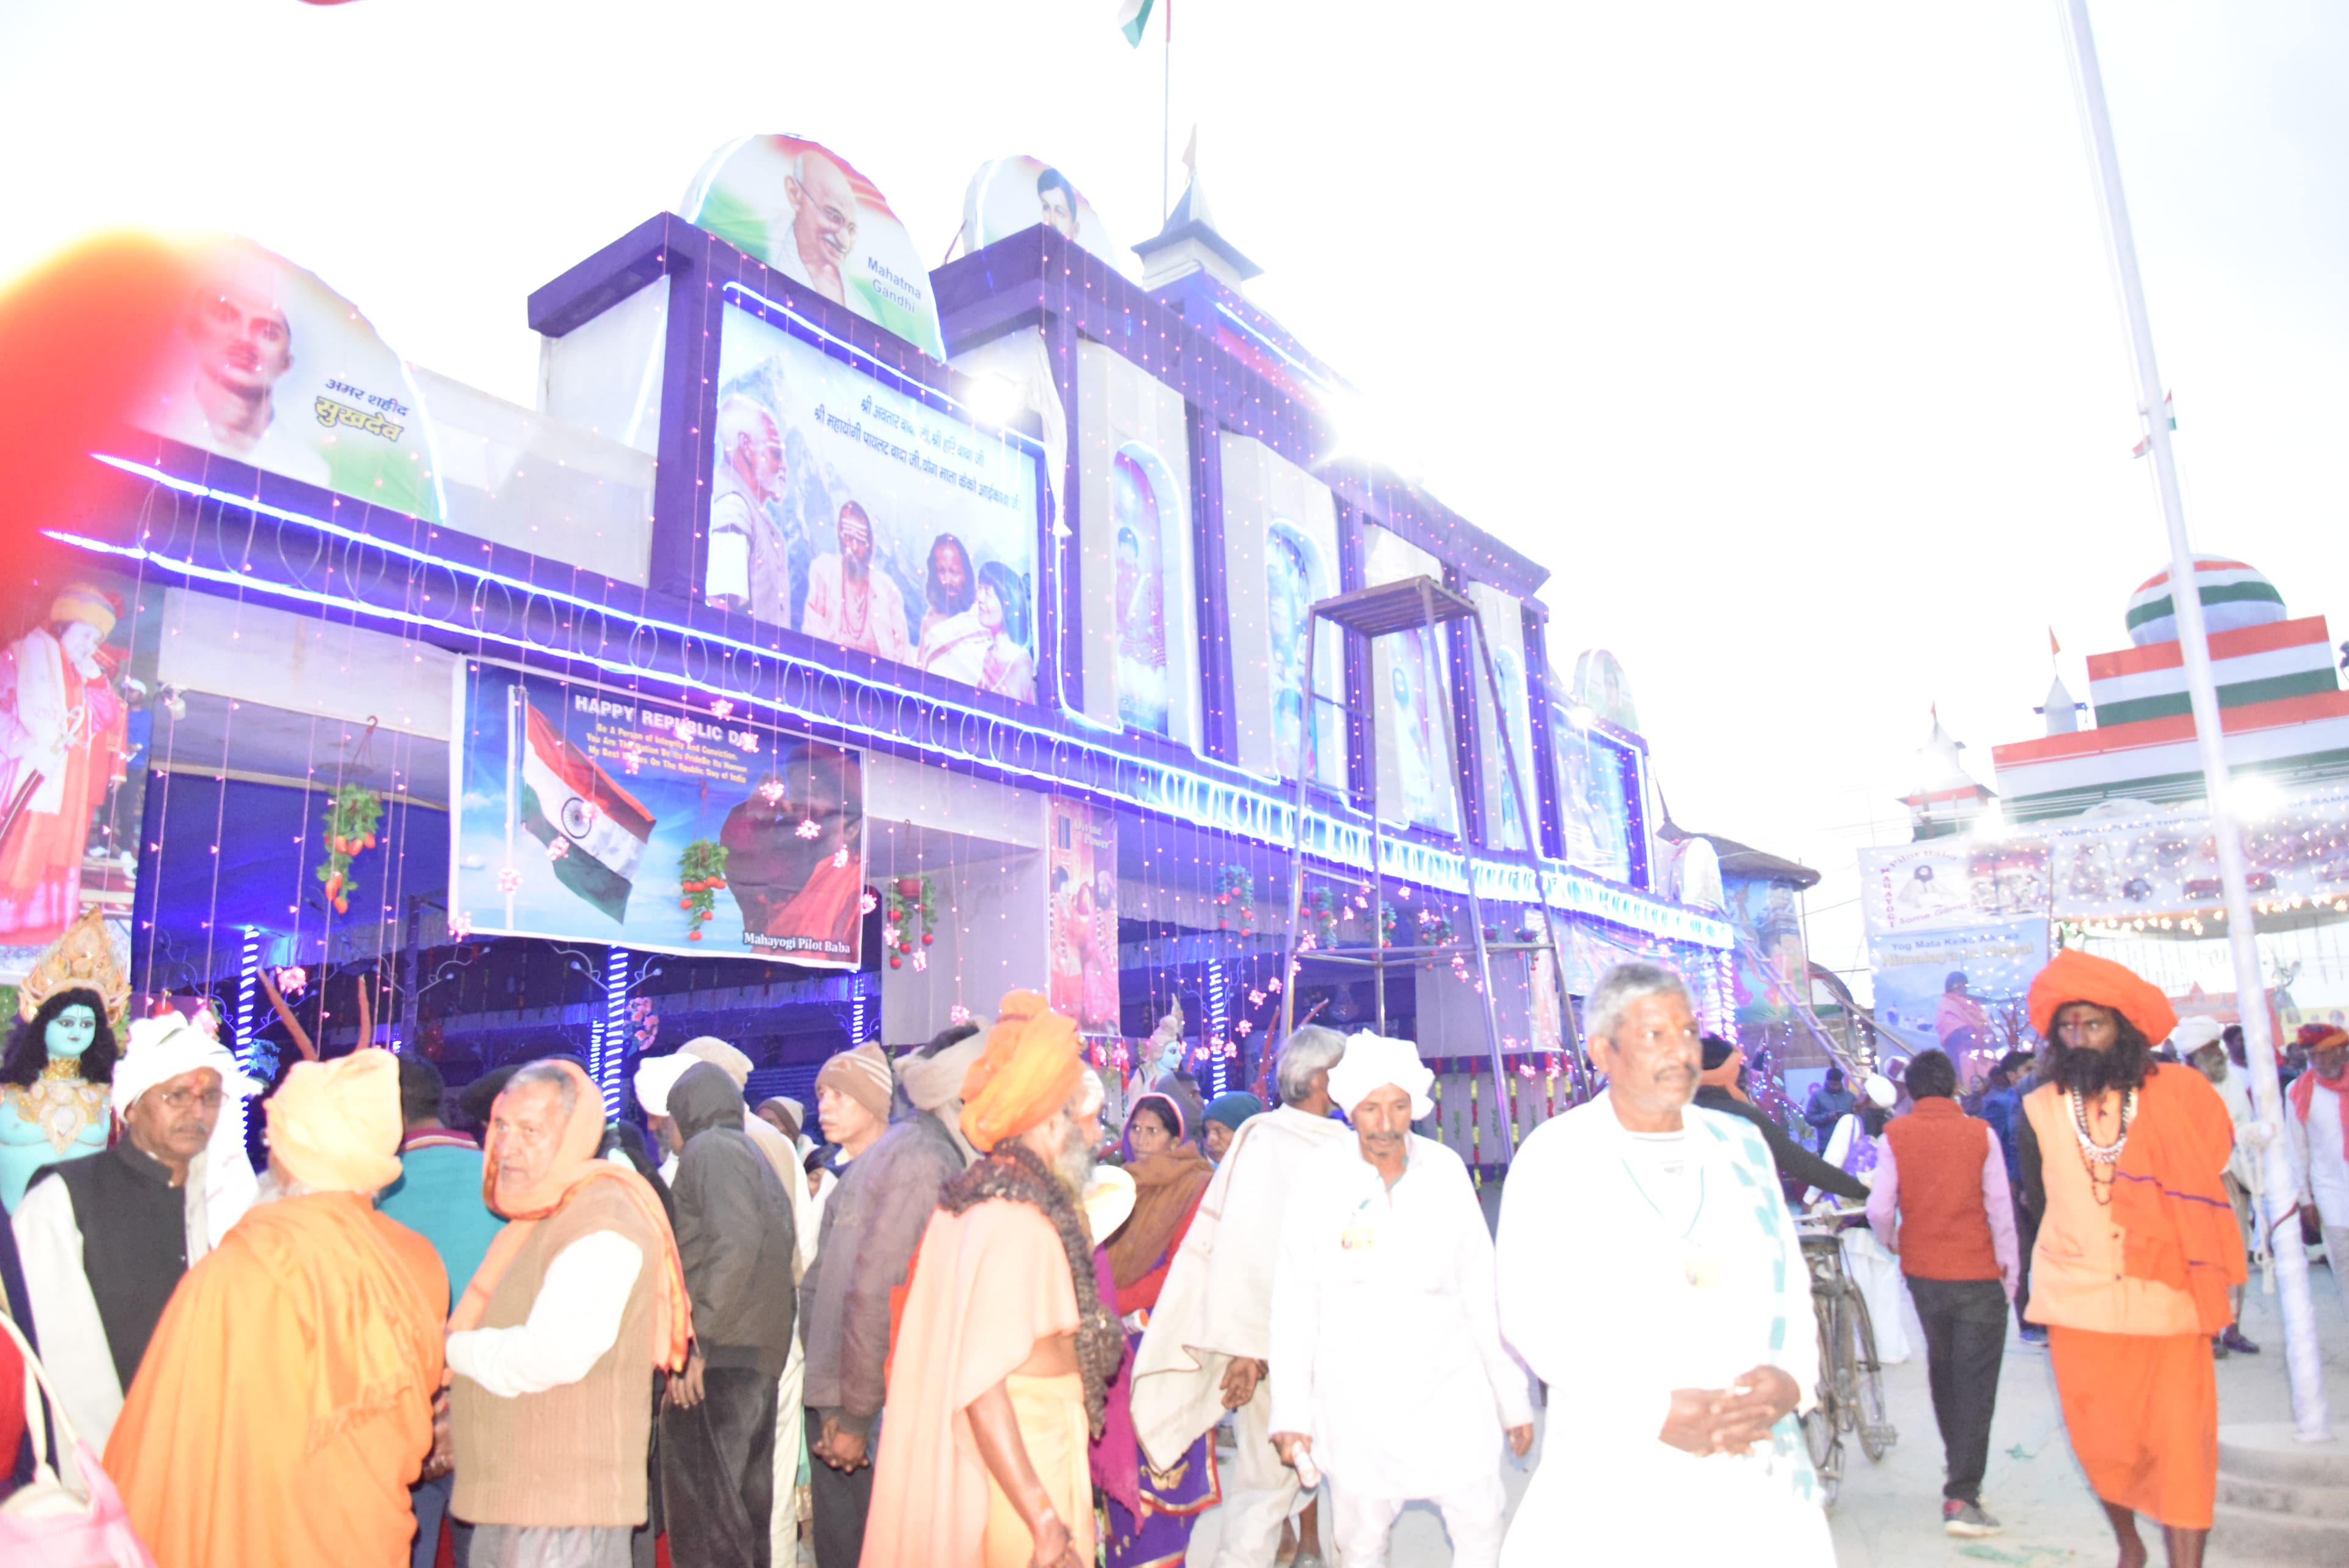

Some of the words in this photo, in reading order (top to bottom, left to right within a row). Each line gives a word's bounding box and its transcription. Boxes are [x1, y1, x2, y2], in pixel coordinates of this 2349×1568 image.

[867, 256, 921, 299] Mahatma
[872, 279, 915, 313] Gandhi
[325, 379, 366, 401] अमर
[368, 394, 410, 417] शहीद
[861, 395, 872, 415] श्री
[873, 405, 899, 429] अवतार
[314, 396, 405, 442] सुखदेव
[814, 403, 825, 425] श्री
[827, 412, 861, 443] महायोगी
[863, 431, 891, 457] पायलट
[891, 444, 907, 464] बाबा
[939, 466, 957, 485] माता
[575, 695, 634, 723] HAPPY
[728, 729, 756, 751] DA
[597, 723, 607, 734] Be
[610, 726, 615, 735] A
[618, 728, 643, 740] Person
[645, 734, 653, 743] of
[655, 735, 685, 750] Integrity
[587, 732, 601, 744] You
[603, 736, 617, 746] Are
[661, 748, 670, 758] Be
[588, 745, 599, 757] My
[602, 748, 620, 760] Best
[650, 757, 661, 767] On
[662, 759, 677, 770] The
[706, 768, 720, 780] Day
[721, 771, 729, 780] of
[730, 773, 747, 784] India
[1074, 817, 1102, 836] Divine
[1084, 833, 1110, 849] Power
[743, 932, 796, 950] Mahayogi
[798, 937, 823, 951] Pilot
[824, 940, 851, 954] Baba
[1891, 942, 1912, 951] Yog
[1915, 939, 1942, 949] Mata
